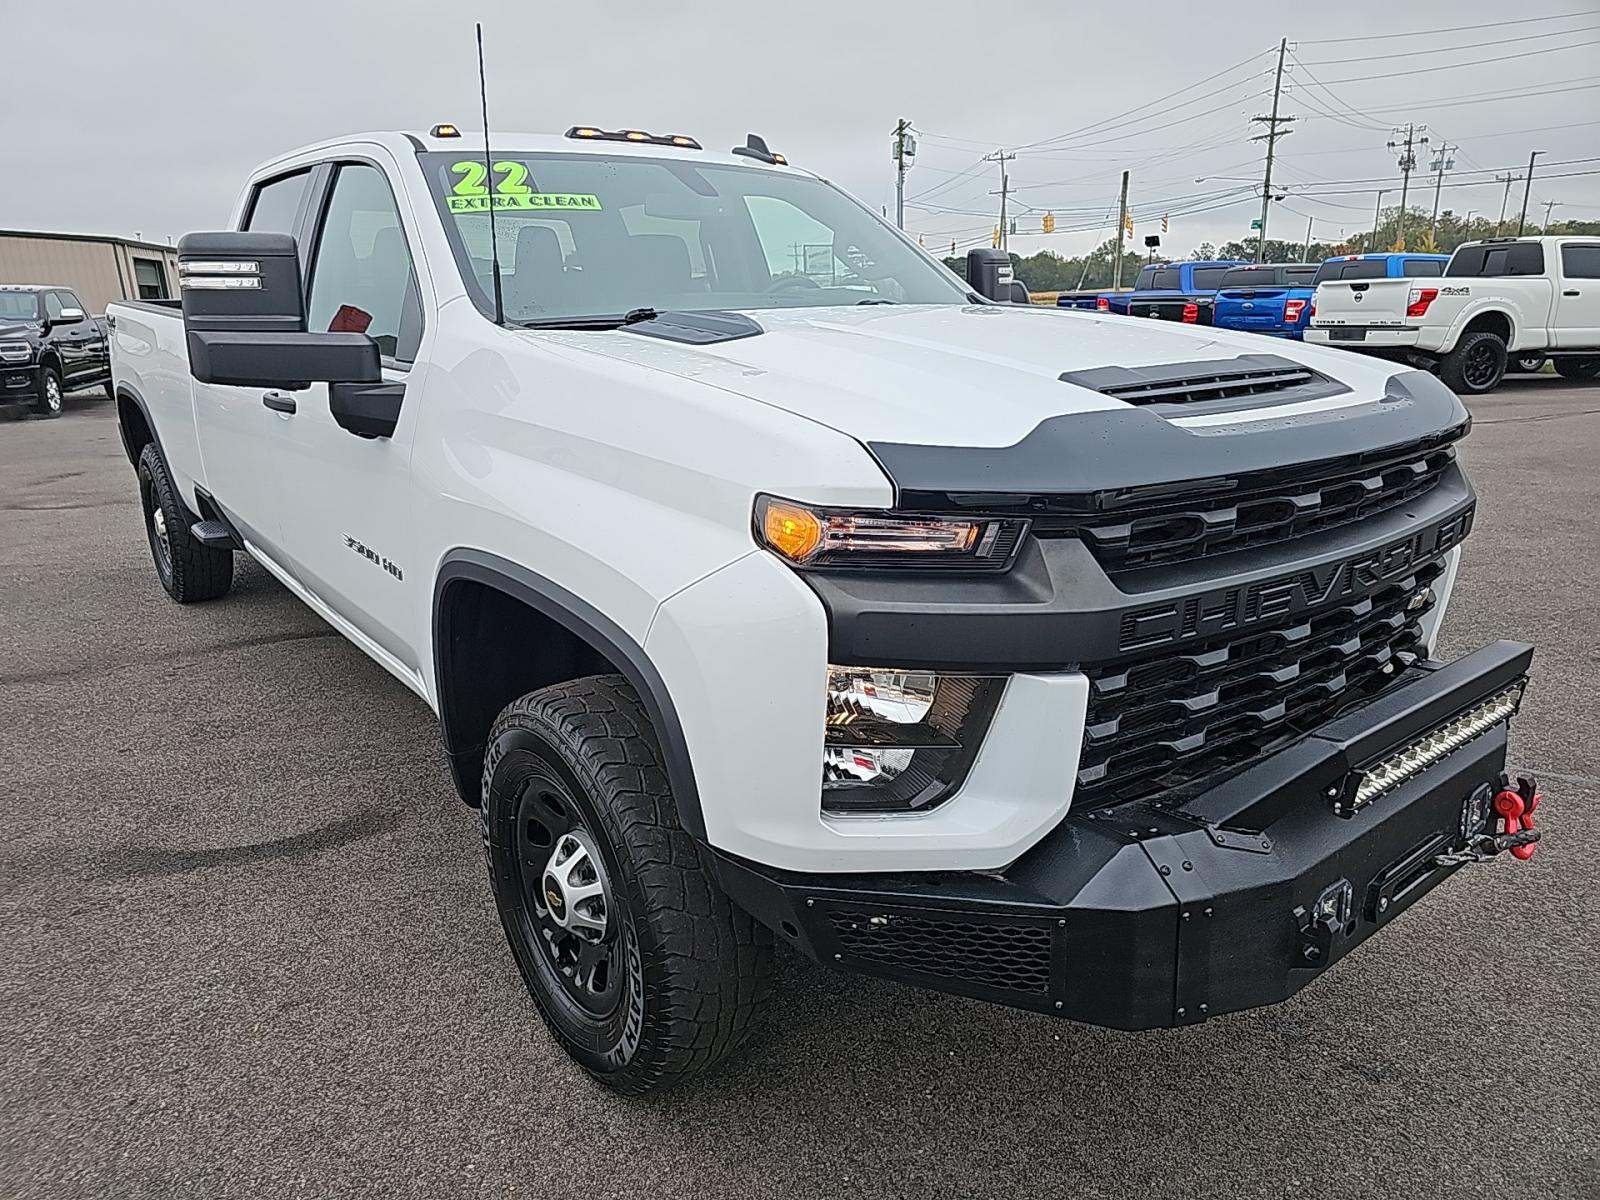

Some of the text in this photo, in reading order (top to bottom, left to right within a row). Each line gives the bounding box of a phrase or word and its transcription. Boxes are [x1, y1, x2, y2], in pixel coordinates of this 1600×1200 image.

[451, 161, 532, 195] 22
[451, 196, 596, 209] EXTRA CLEAN
[1119, 507, 1473, 651] CHEVROLET
